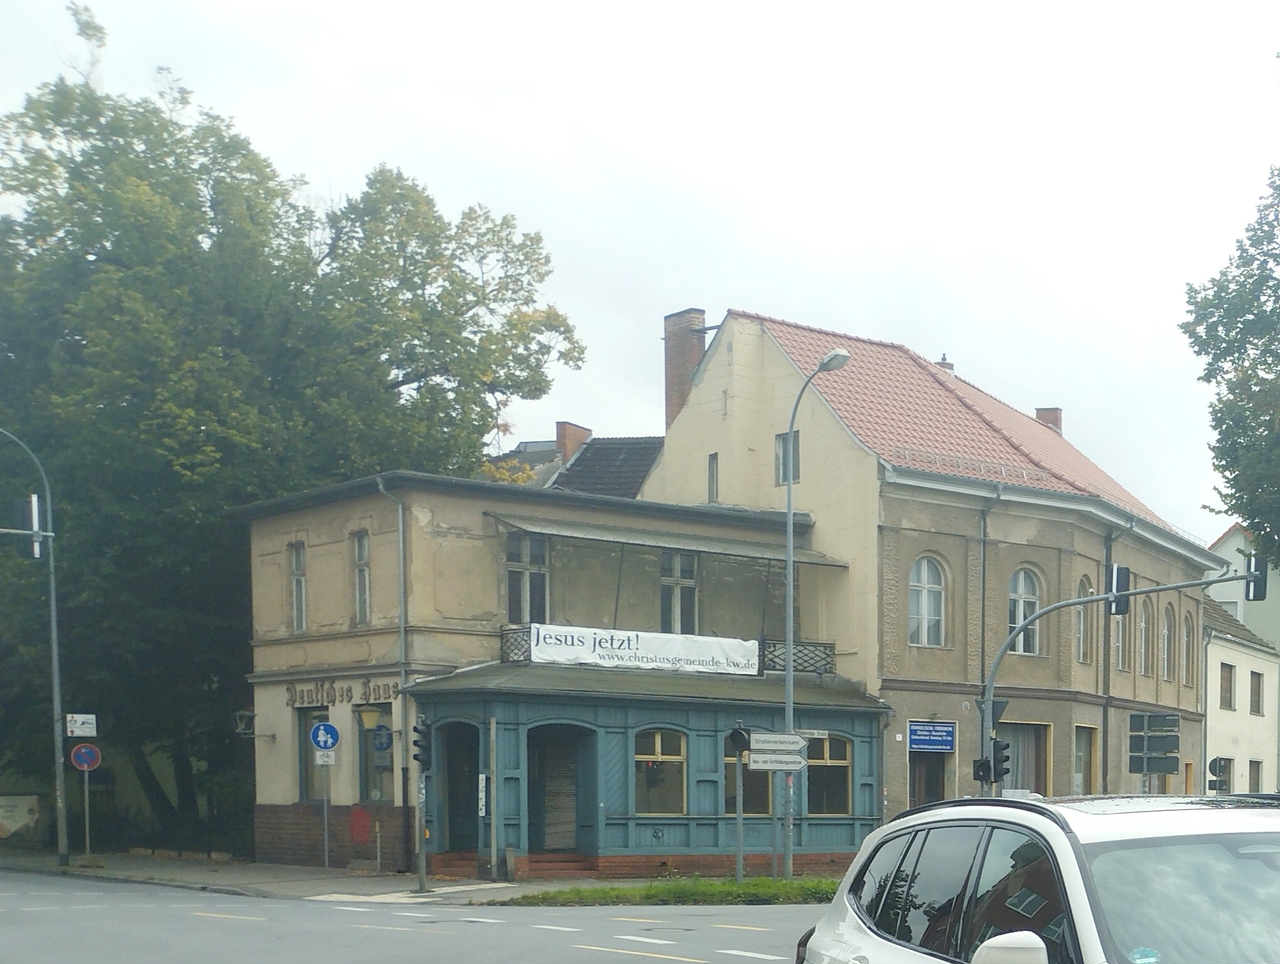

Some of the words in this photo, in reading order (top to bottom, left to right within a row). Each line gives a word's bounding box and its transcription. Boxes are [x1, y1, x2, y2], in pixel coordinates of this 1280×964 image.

[534, 627, 585, 647] Jesus
[591, 632, 640, 653] jetzt!
[598, 652, 757, 670] www.christusgemeinde-kw.de
